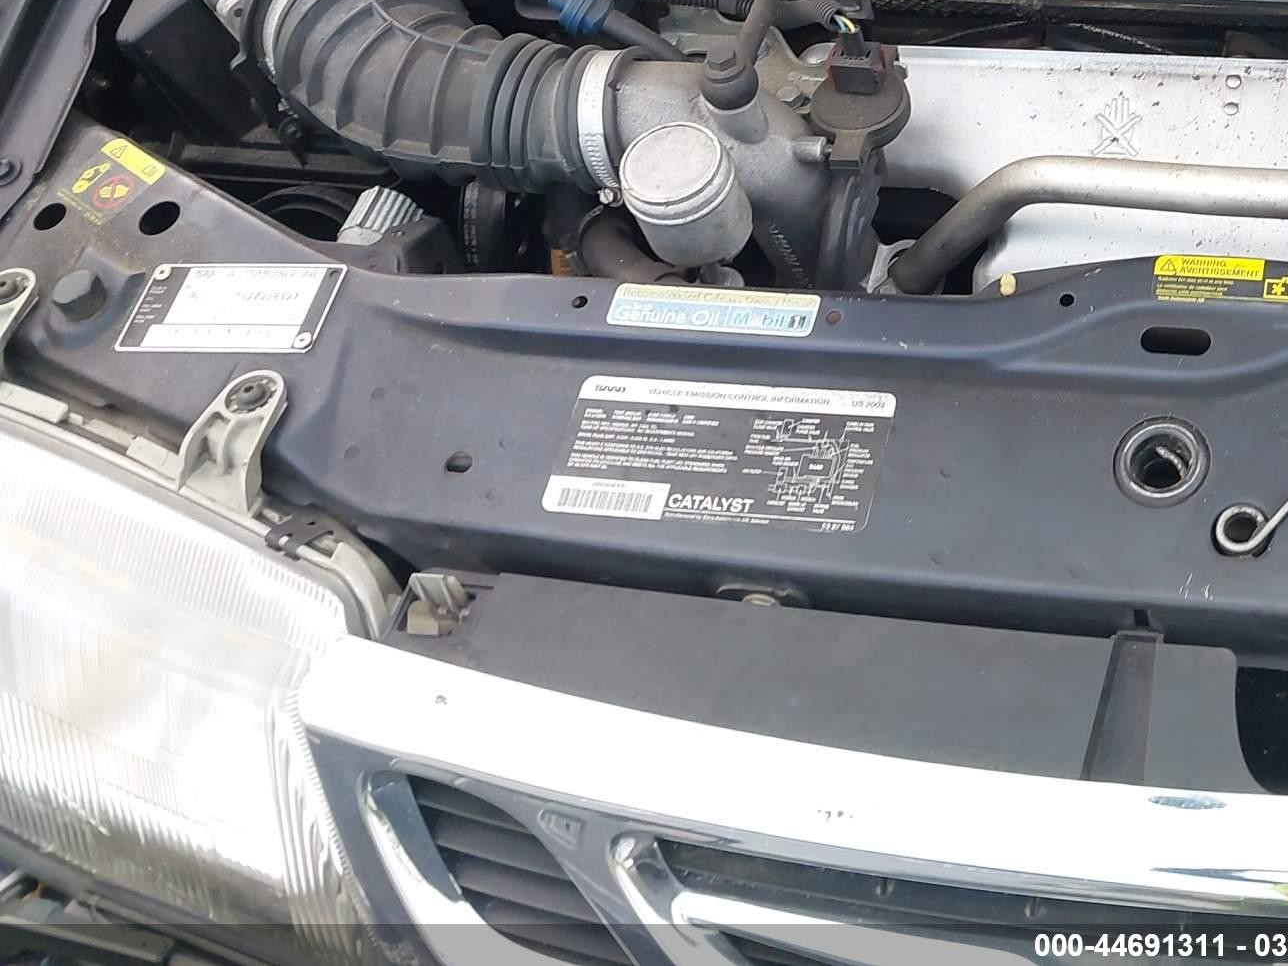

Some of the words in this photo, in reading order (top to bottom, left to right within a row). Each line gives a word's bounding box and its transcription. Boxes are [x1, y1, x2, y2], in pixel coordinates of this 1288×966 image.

[1181, 258, 1227, 267] WARNING
[1179, 265, 1259, 277] AVERTISSEMENT
[615, 305, 687, 325] Genuine
[692, 311, 720, 327] Oil
[667, 493, 754, 513] CATALYST
